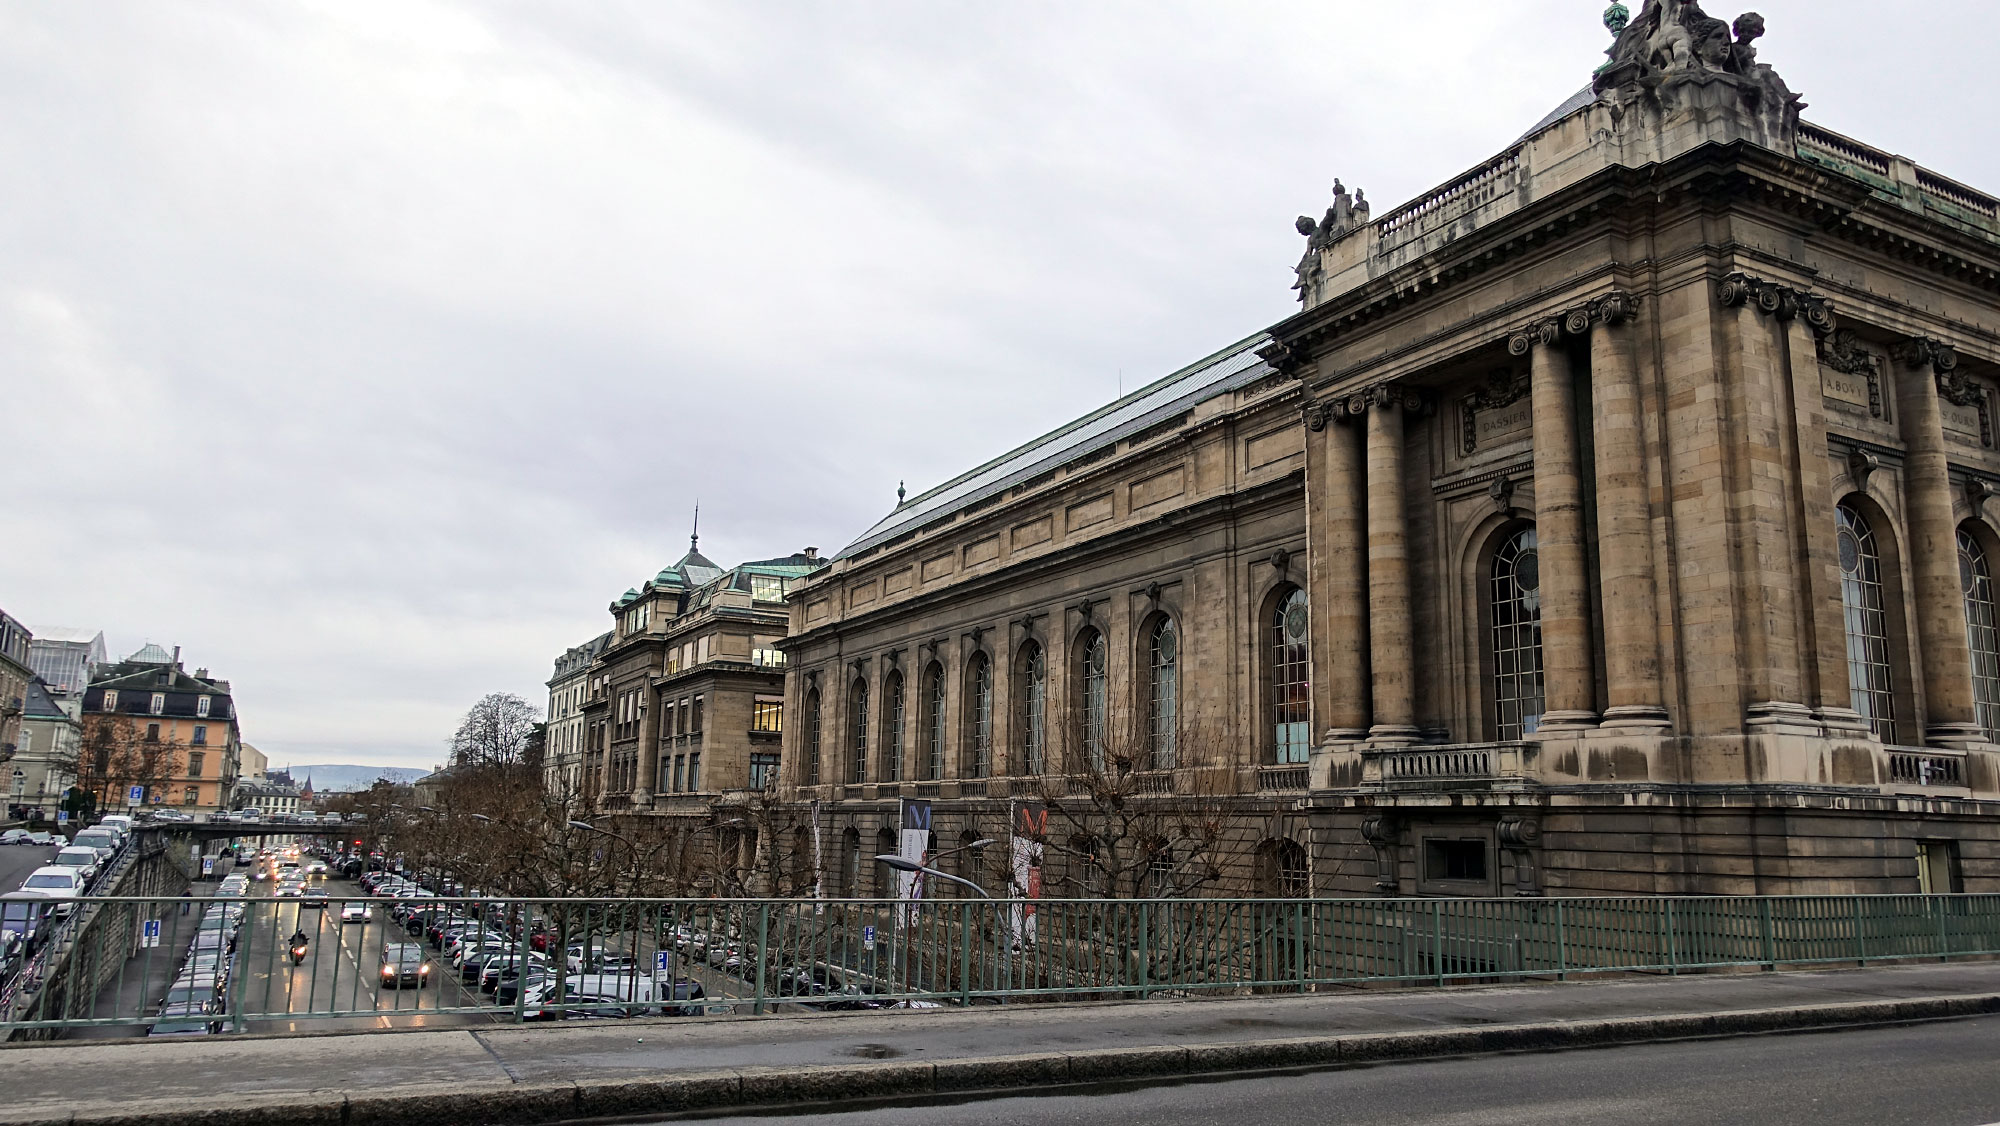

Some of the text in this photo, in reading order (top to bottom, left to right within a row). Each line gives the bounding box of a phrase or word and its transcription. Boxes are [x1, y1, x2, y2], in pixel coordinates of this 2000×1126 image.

[1483, 411, 1527, 432] DASSIER
[1951, 412, 1976, 427] OURS
[909, 805, 931, 830] M
[1020, 808, 1048, 835] M
